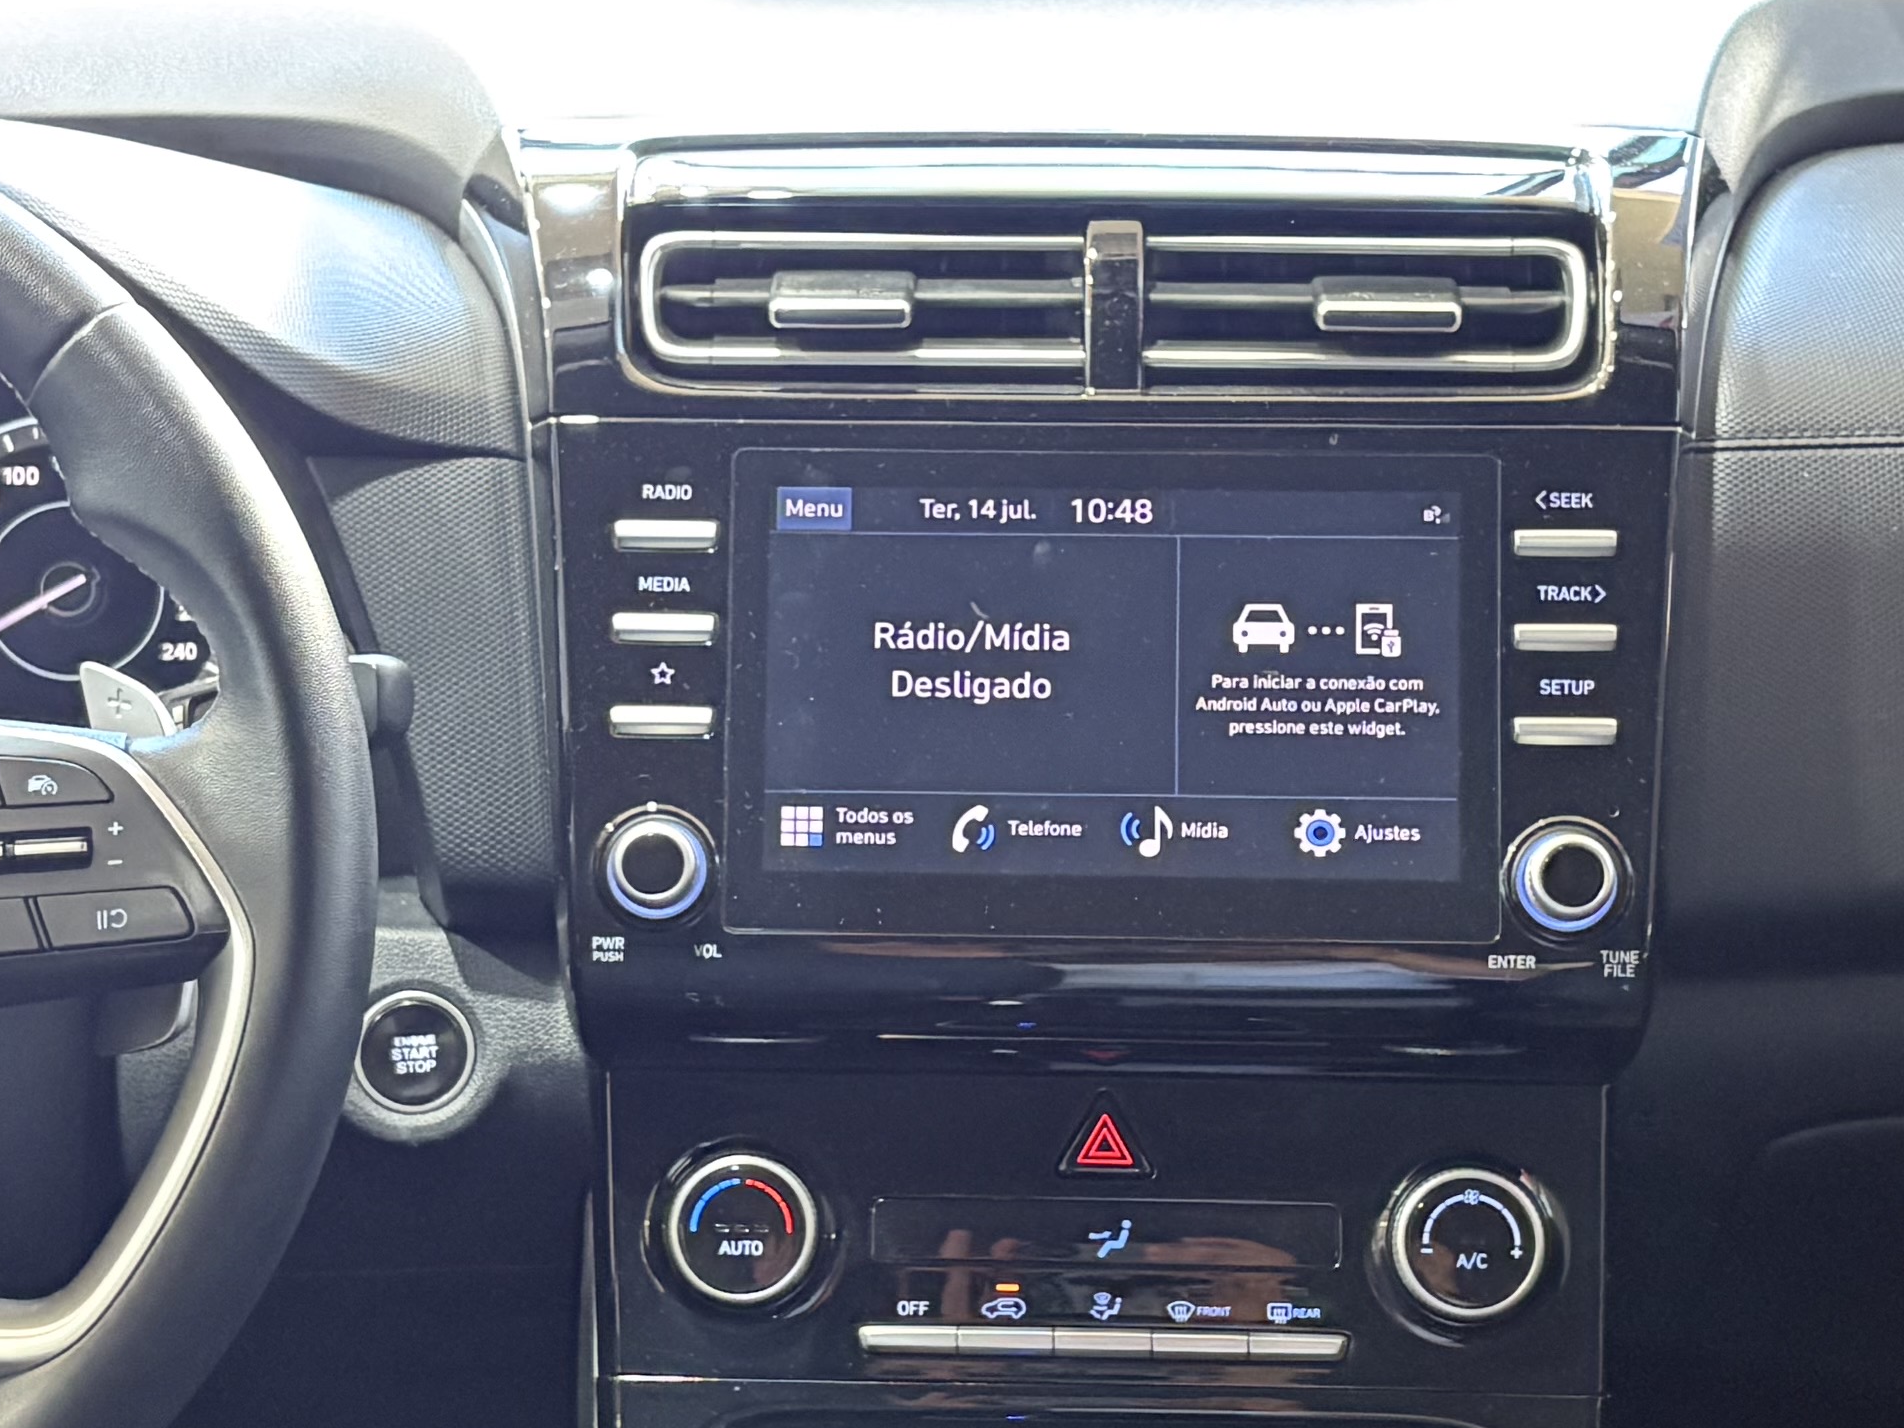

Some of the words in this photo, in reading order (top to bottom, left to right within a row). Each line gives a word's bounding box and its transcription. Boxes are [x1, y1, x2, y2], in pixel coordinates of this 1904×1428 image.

[1, 465, 40, 486] 100
[641, 483, 693, 502] RADIO
[1549, 493, 1594, 509] SEEK
[785, 498, 844, 519] Menu
[919, 498, 962, 522] Ter,
[968, 499, 997, 520] 14
[998, 498, 1037, 524] jul.
[1071, 498, 1154, 525] 10:48
[637, 576, 691, 594] MEDIA
[1537, 585, 1593, 602] TRACK
[873, 620, 1071, 654] Rádio/Mídia
[160, 642, 198, 662] 240
[890, 670, 1052, 704] Desligado
[1211, 673, 1249, 690] Para
[1253, 673, 1302, 690] iniciar
[1305, 677, 1316, 690] a
[1319, 675, 1386, 691] conexão
[1388, 678, 1424, 691] com
[1539, 679, 1595, 696] SETUP
[1195, 697, 1257, 712] Android
[1260, 697, 1298, 712] Auto
[1301, 701, 1321, 712] ou
[1324, 698, 1370, 715] Apple
[1228, 721, 1305, 737] pressione
[1309, 722, 1343, 735] este
[1348, 721, 1406, 738] widget.
[835, 807, 888, 825] Todos
[892, 810, 915, 825] os
[1007, 820, 1083, 838] Telefone
[1180, 821, 1229, 840] Mídia
[1353, 824, 1421, 845] Ajustes
[835, 831, 897, 846] menus
[591, 936, 625, 951] PWR
[694, 943, 722, 959] VOL
[591, 950, 624, 963] PUSH
[1487, 955, 1537, 970] ENTER
[1599, 950, 1639, 965] TUNE
[1603, 963, 1636, 979] FILE
[391, 1046, 439, 1061] START
[396, 1059, 437, 1075] STOP
[717, 1239, 764, 1257] AUTO
[1455, 1251, 1489, 1271] A/C
[896, 1300, 930, 1317] OFF
[1196, 1305, 1231, 1319] FRONT
[1292, 1307, 1321, 1320] REAR
